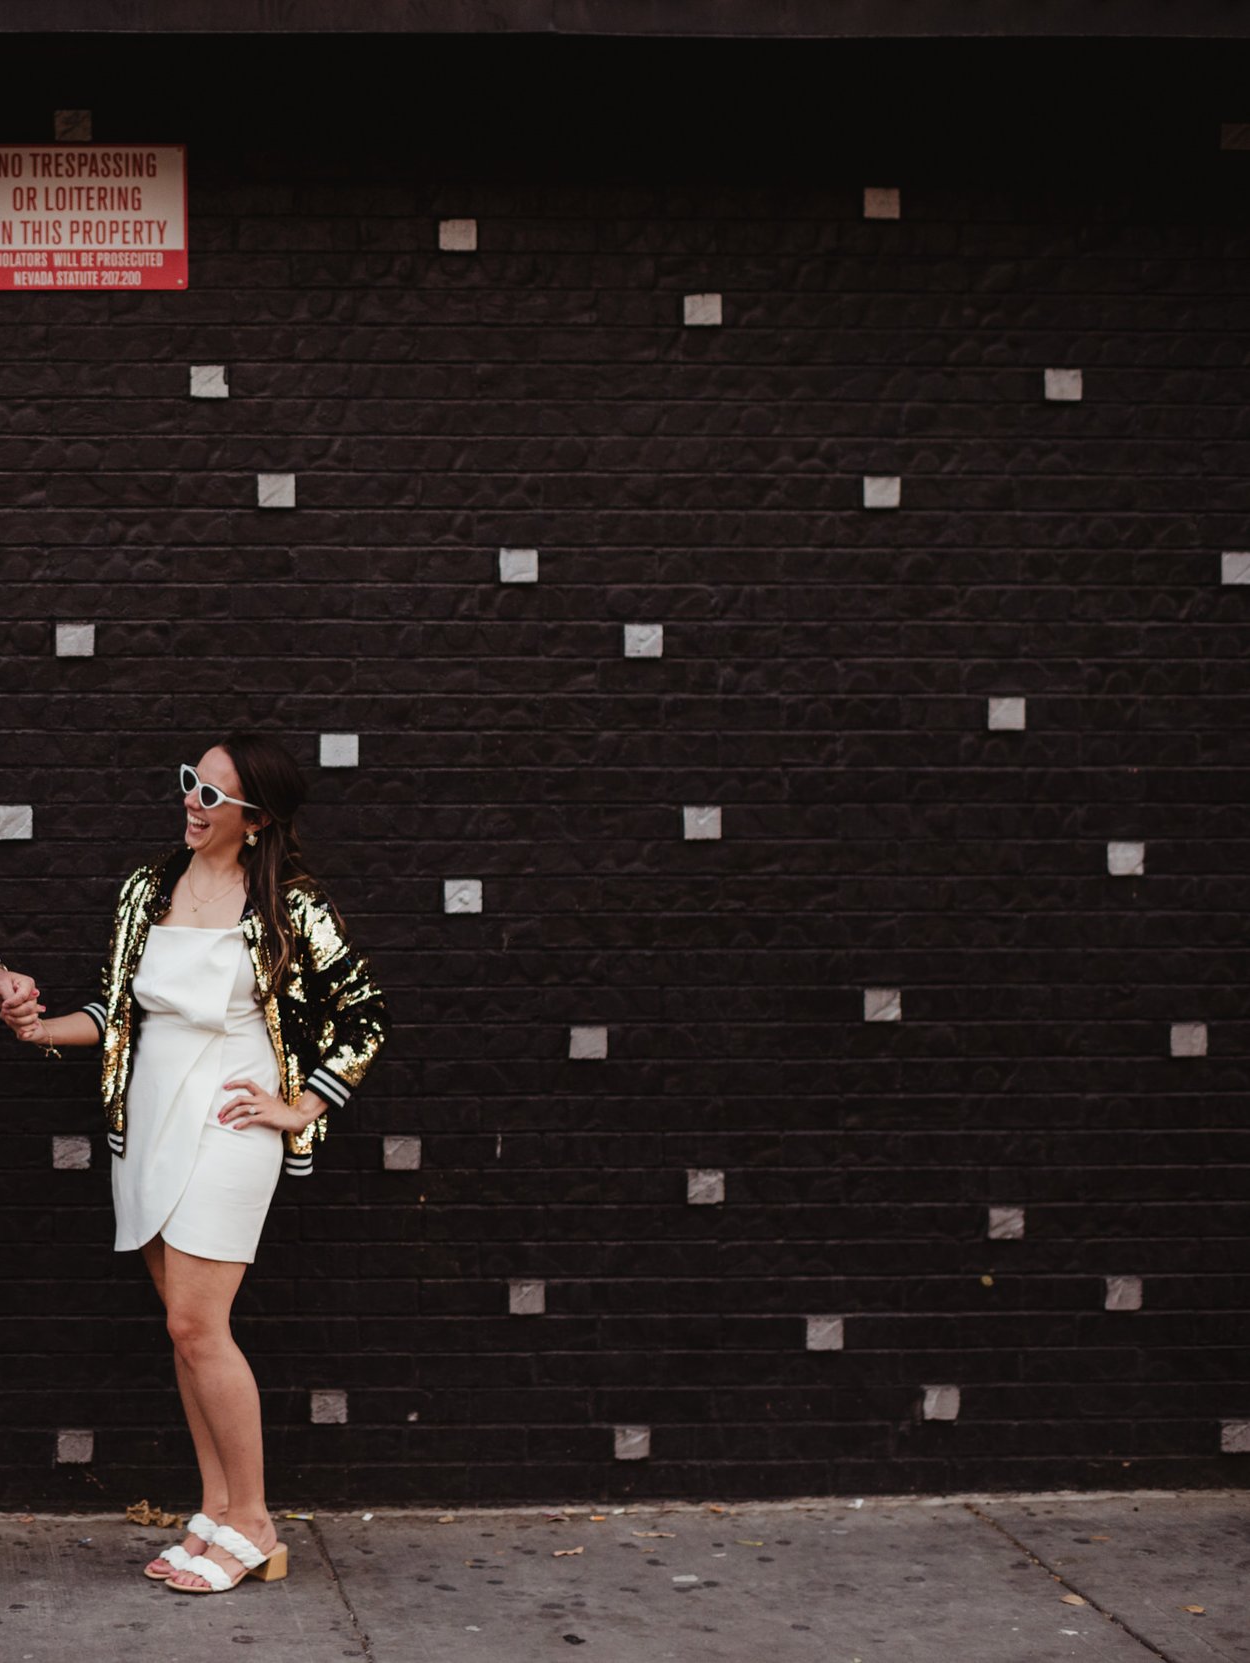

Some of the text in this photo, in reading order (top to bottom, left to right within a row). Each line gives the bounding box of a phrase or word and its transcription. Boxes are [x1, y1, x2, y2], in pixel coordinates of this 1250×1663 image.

[29, 152, 157, 178] TRESPASSING
[12, 186, 142, 211] OR LOITERING
[20, 220, 62, 245] THIS
[69, 220, 168, 245] PROPERTY
[53, 252, 78, 267] WILL
[81, 252, 94, 267] BE
[96, 252, 164, 267] PROSECUTED
[13, 271, 54, 286] NEVADA
[56, 271, 98, 286] STATUTE
